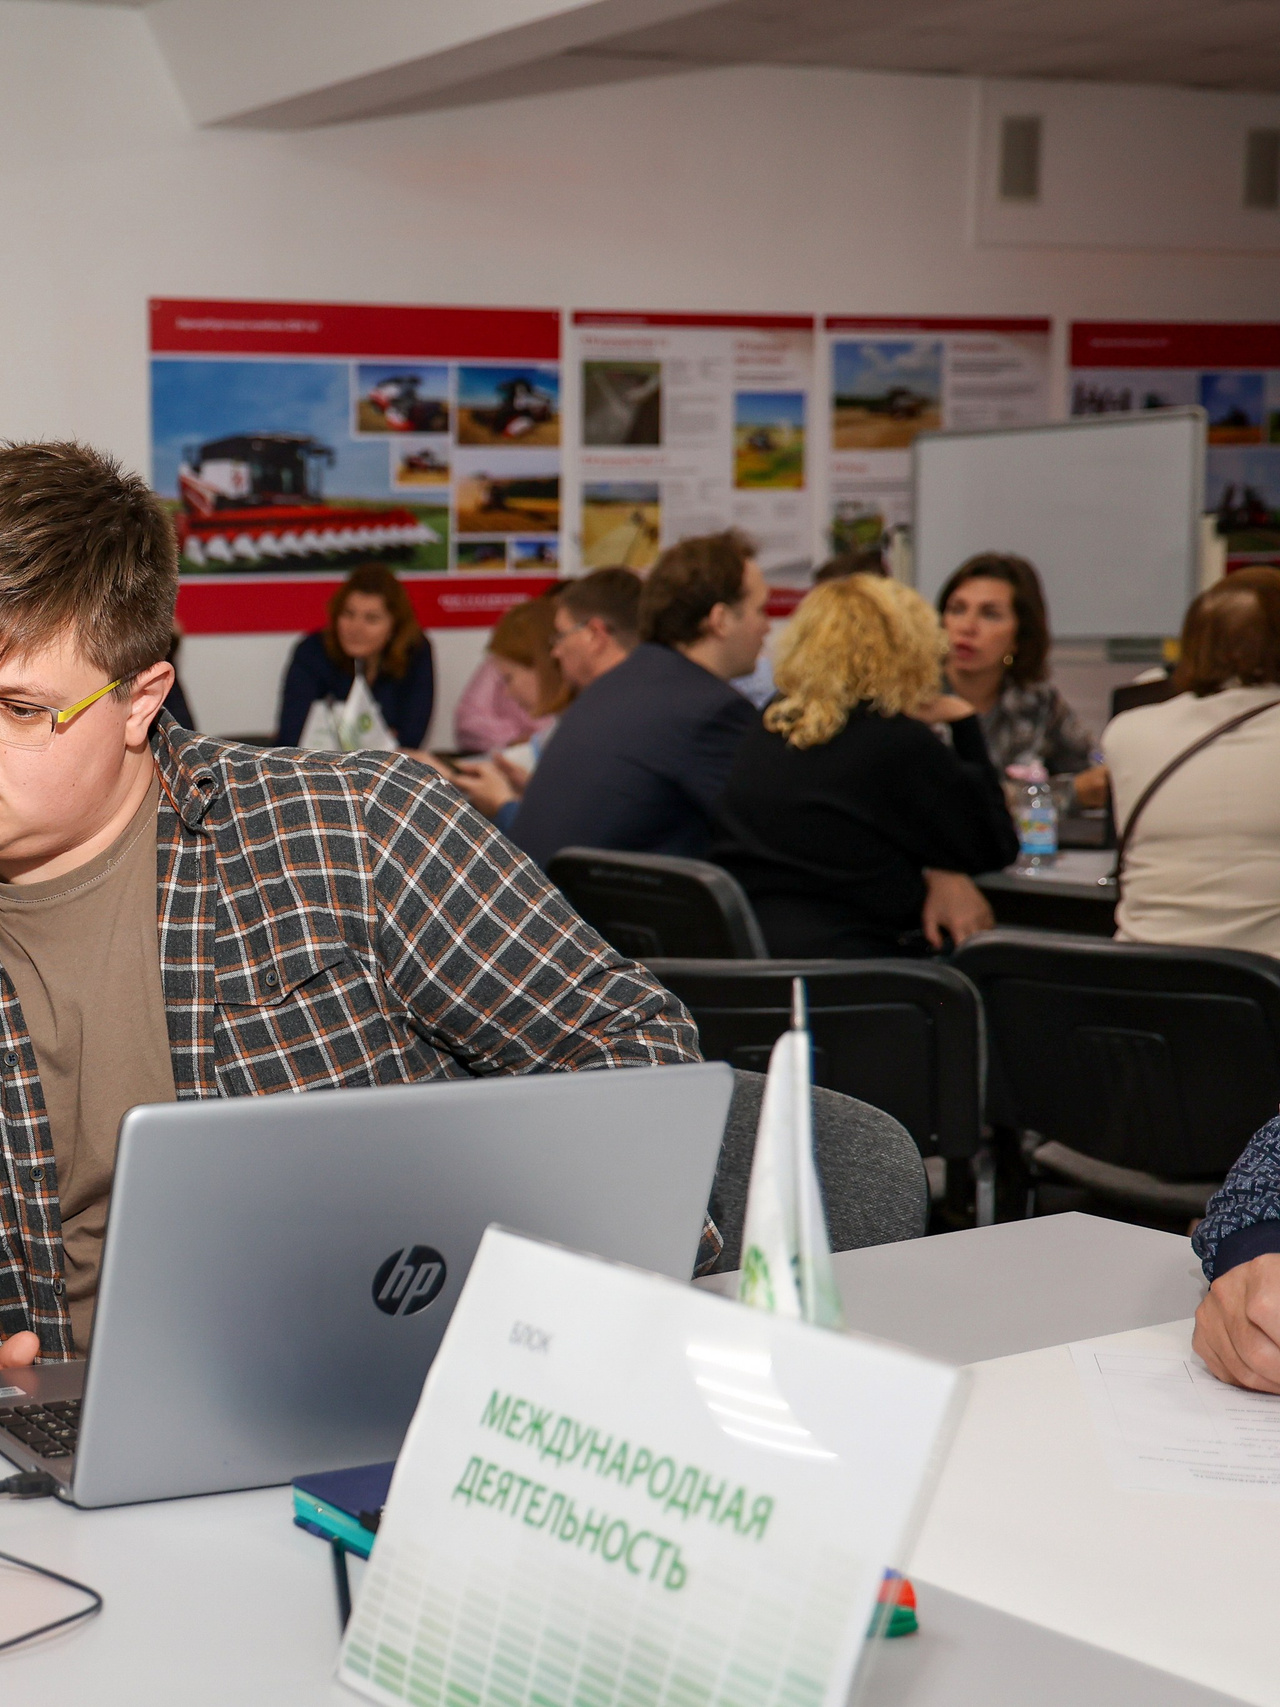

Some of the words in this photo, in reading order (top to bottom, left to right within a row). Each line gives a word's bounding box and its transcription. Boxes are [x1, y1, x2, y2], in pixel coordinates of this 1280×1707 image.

[374, 1245, 445, 1317] hp
[508, 1320, 553, 1355] БЛОК
[480, 1388, 774, 1541] МЕЖДУНАРОДНАЯ
[452, 1454, 688, 1591] ДЕЯТЕЛЬНОСТЬ
